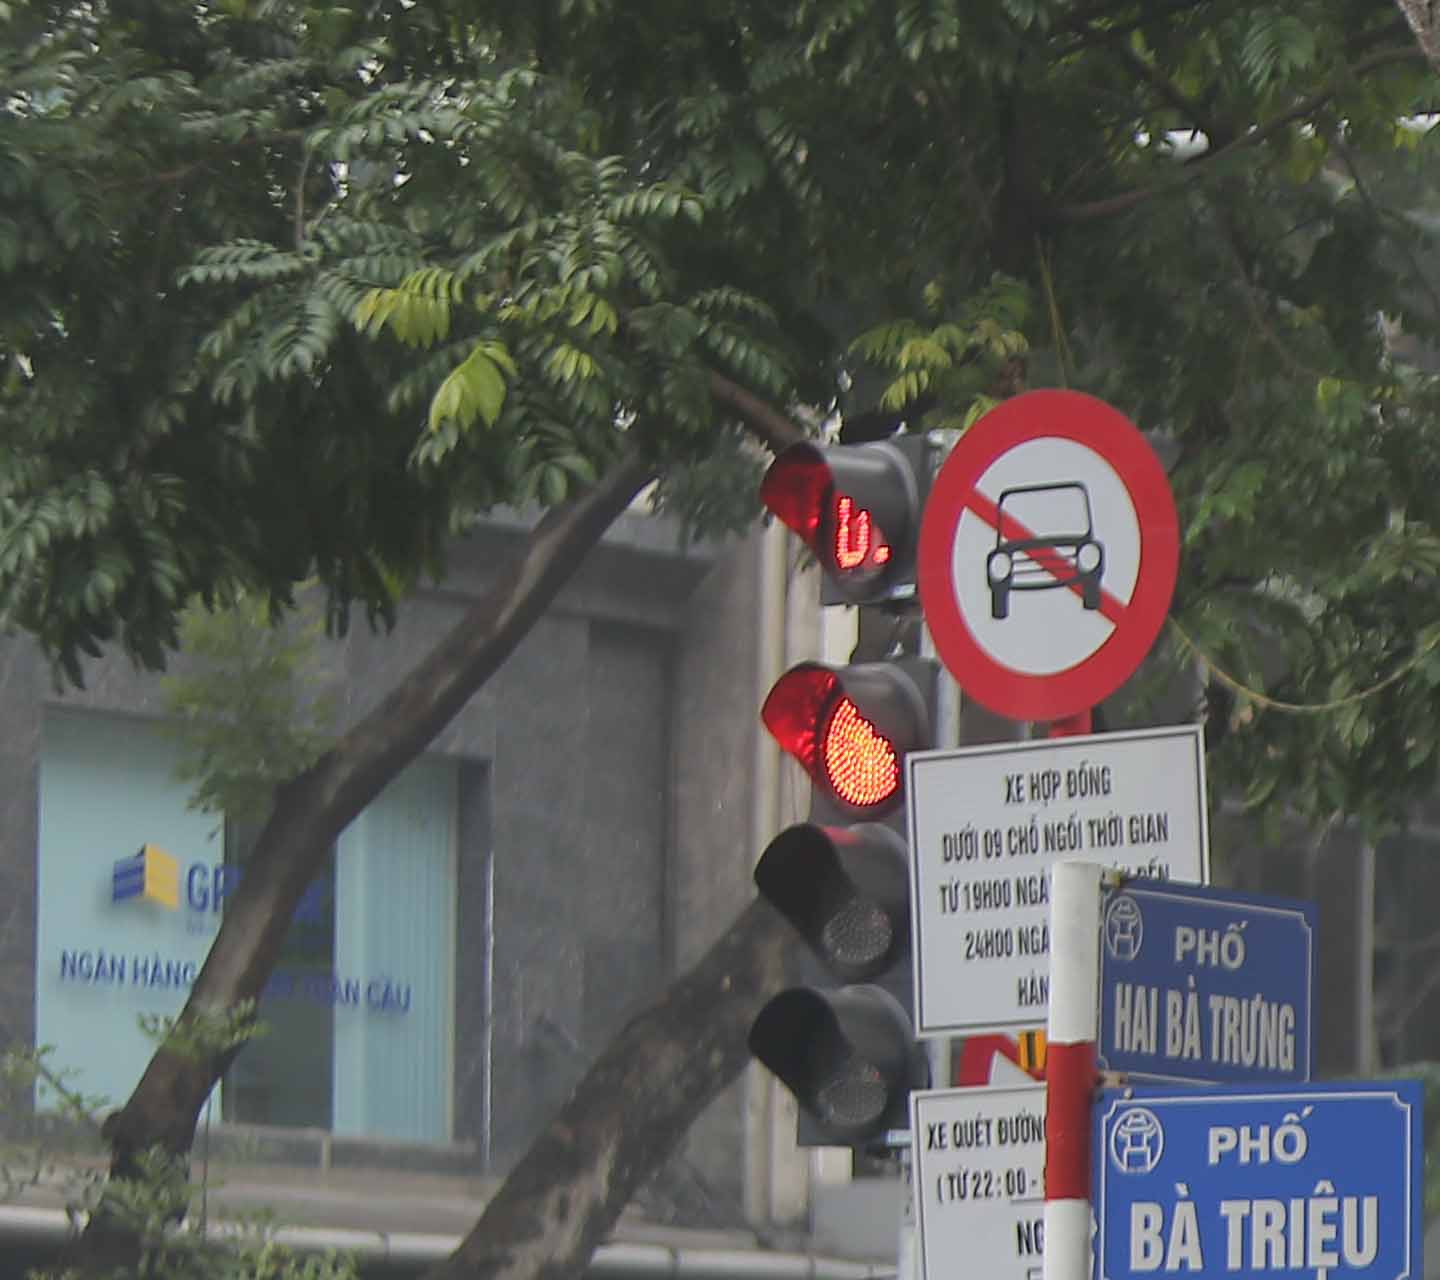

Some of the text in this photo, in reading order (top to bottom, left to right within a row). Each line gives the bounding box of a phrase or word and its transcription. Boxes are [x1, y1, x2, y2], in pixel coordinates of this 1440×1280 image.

[1005, 760, 1112, 808] XE HỢP ĐỒNG
[943, 820, 979, 863] DƯỚI
[984, 829, 1002, 860] 09
[1129, 811, 1169, 845] GIAN
[940, 877, 961, 915] TỪ
[964, 880, 1012, 914] 19H00
[1016, 867, 1051, 906] NGÀ
[965, 917, 1051, 961] 24H00 NGÀ
[1175, 920, 1248, 970] PHỐ
[1017, 967, 1050, 1008] HÀN
[1114, 974, 1295, 1072] HAI BÀ TRƯNG
[927, 1108, 1046, 1151] XE QUÉT ĐƯỜN
[1208, 1104, 1315, 1166] PHỐ
[1129, 1182, 1204, 1272] BÀ
